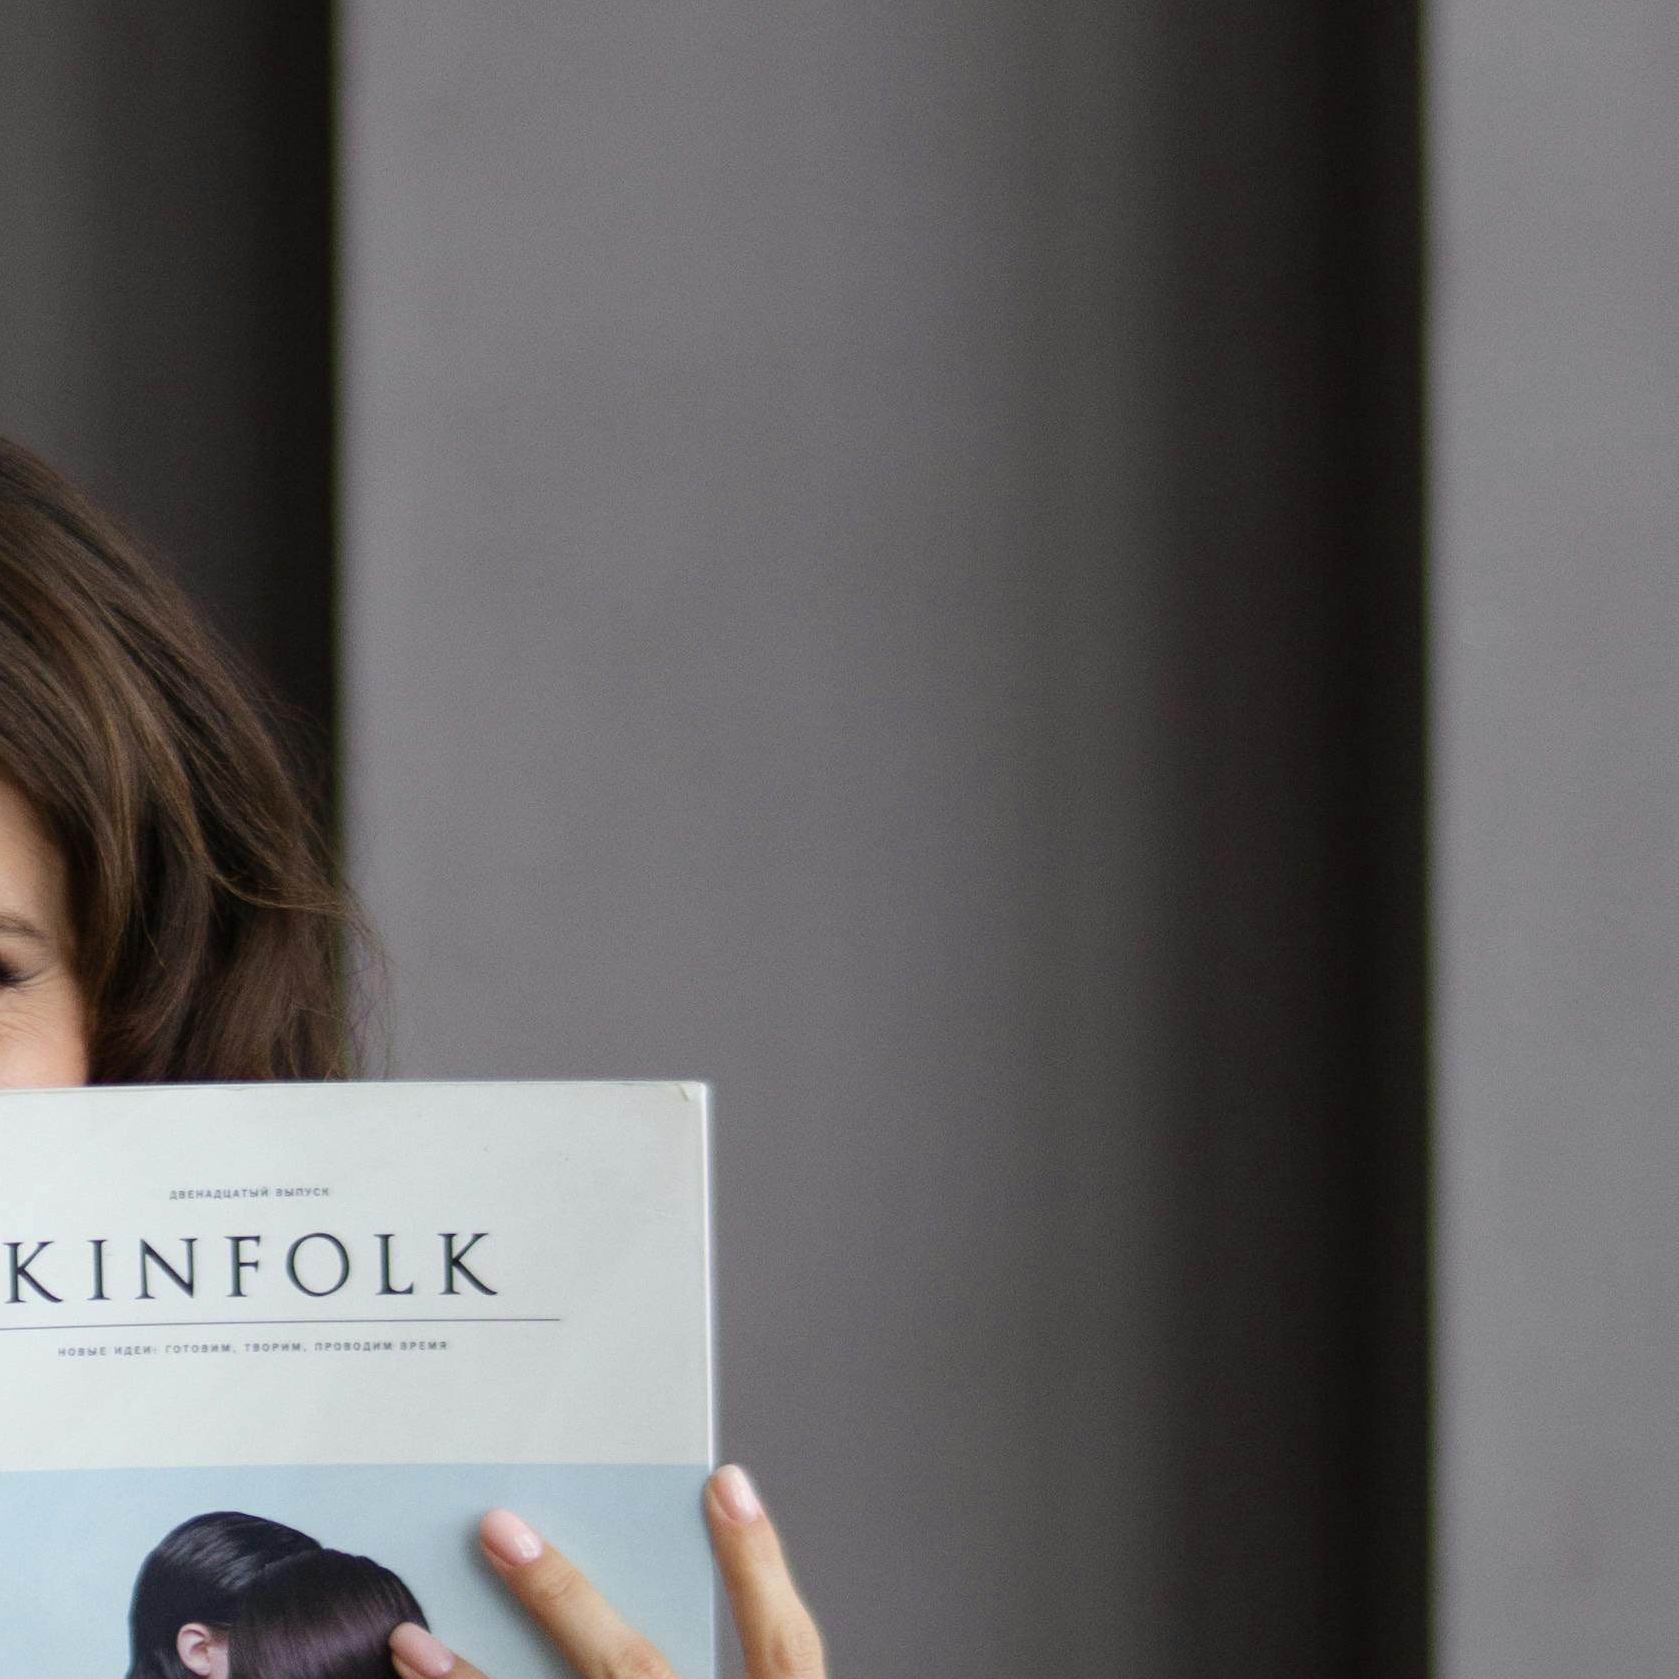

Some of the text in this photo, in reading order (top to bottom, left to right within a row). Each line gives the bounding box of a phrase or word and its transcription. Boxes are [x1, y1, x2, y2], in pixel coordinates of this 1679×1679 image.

[169, 1186, 330, 1200] ДВЕНАДЦАТЫЙ ВЫПУСК
[2, 1232, 498, 1304] KINFOLK
[57, 1340, 449, 1357] НОВЫЕ ИДЕИ: ГОТОВИМ, ТВОРИМ, ПРОВОДИМ ВРЕМЯ
